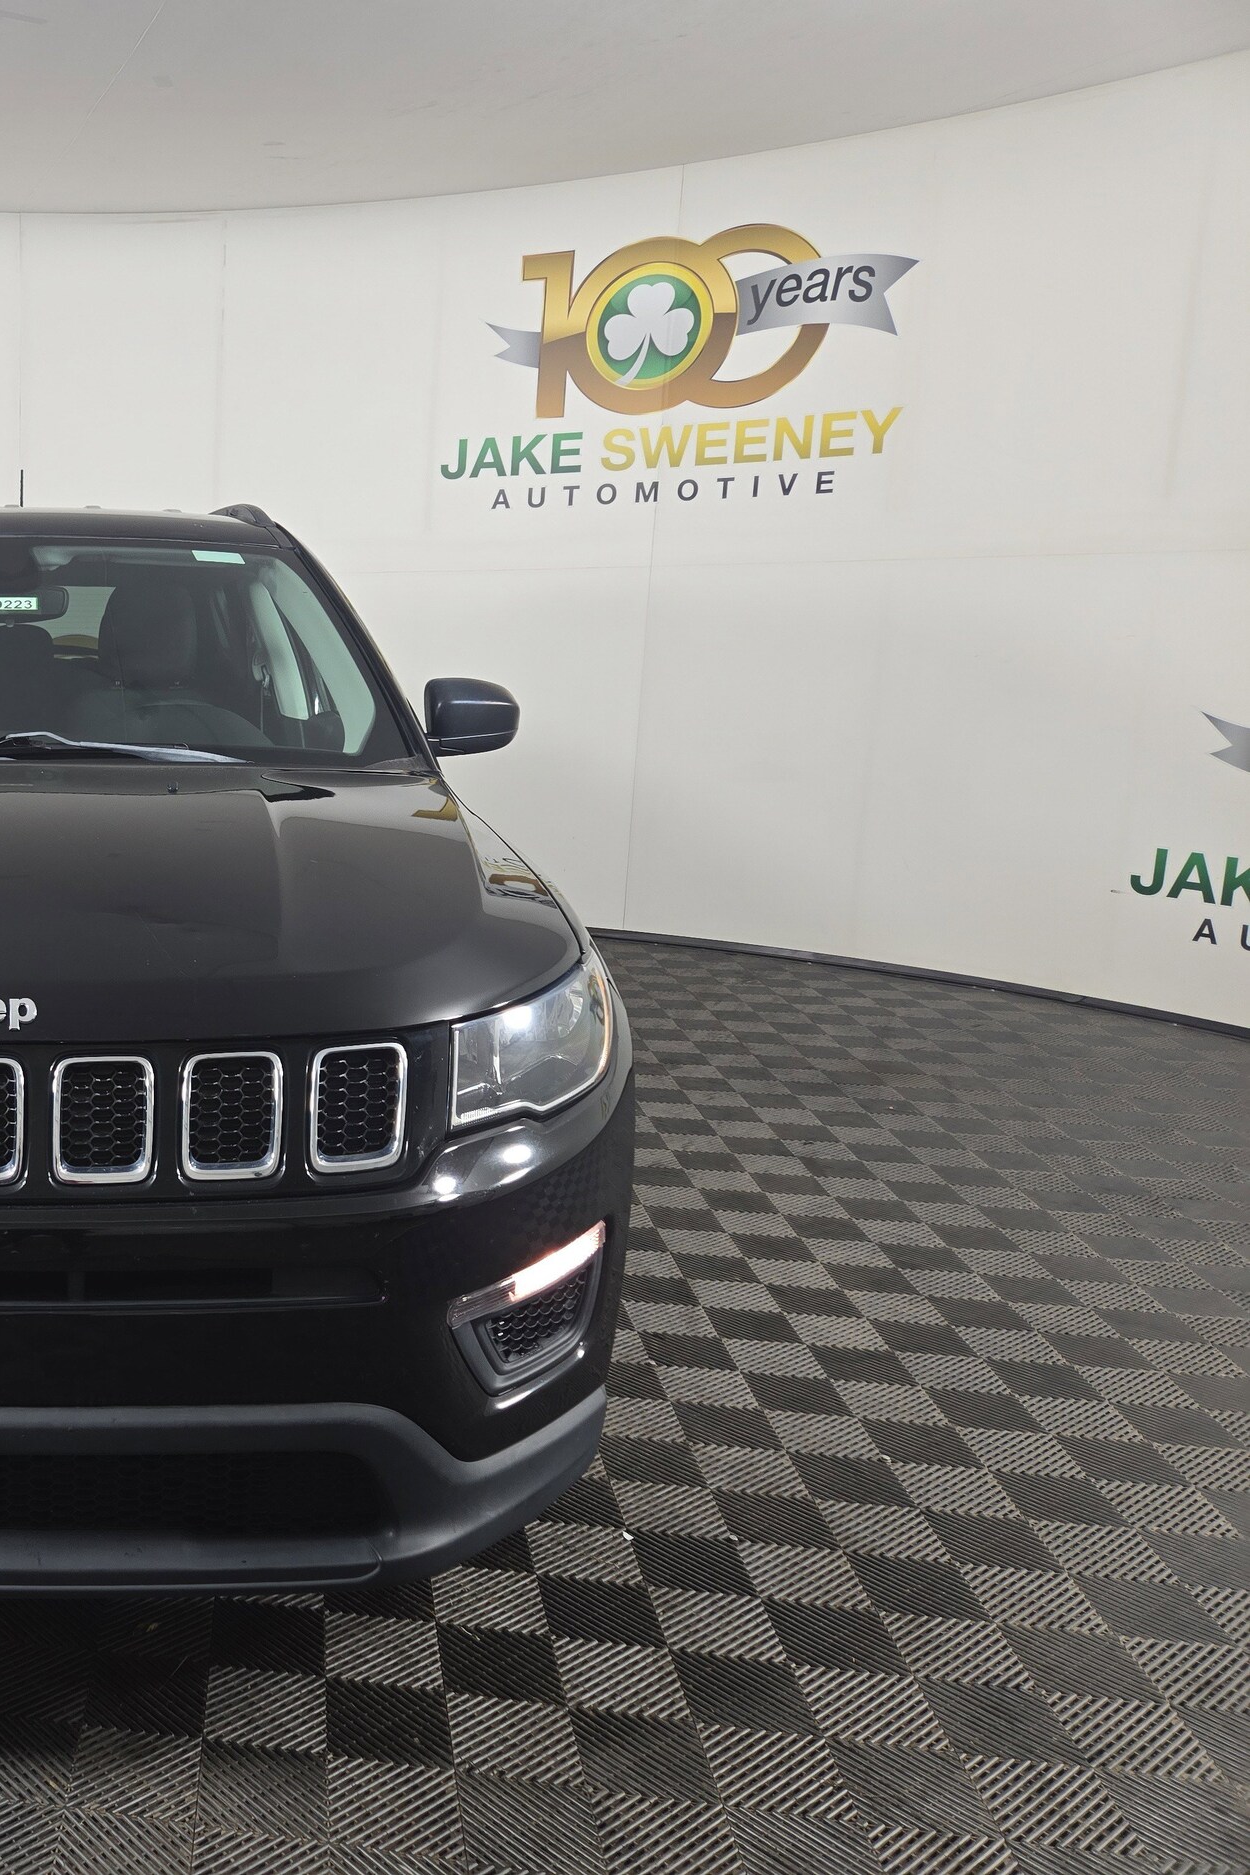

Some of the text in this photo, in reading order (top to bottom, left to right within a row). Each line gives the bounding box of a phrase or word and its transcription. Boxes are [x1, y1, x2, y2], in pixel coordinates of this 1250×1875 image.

[746, 264, 876, 325] years
[441, 406, 904, 481] JAKE SWEENEY
[491, 470, 836, 511] AUTOMOTIVE
